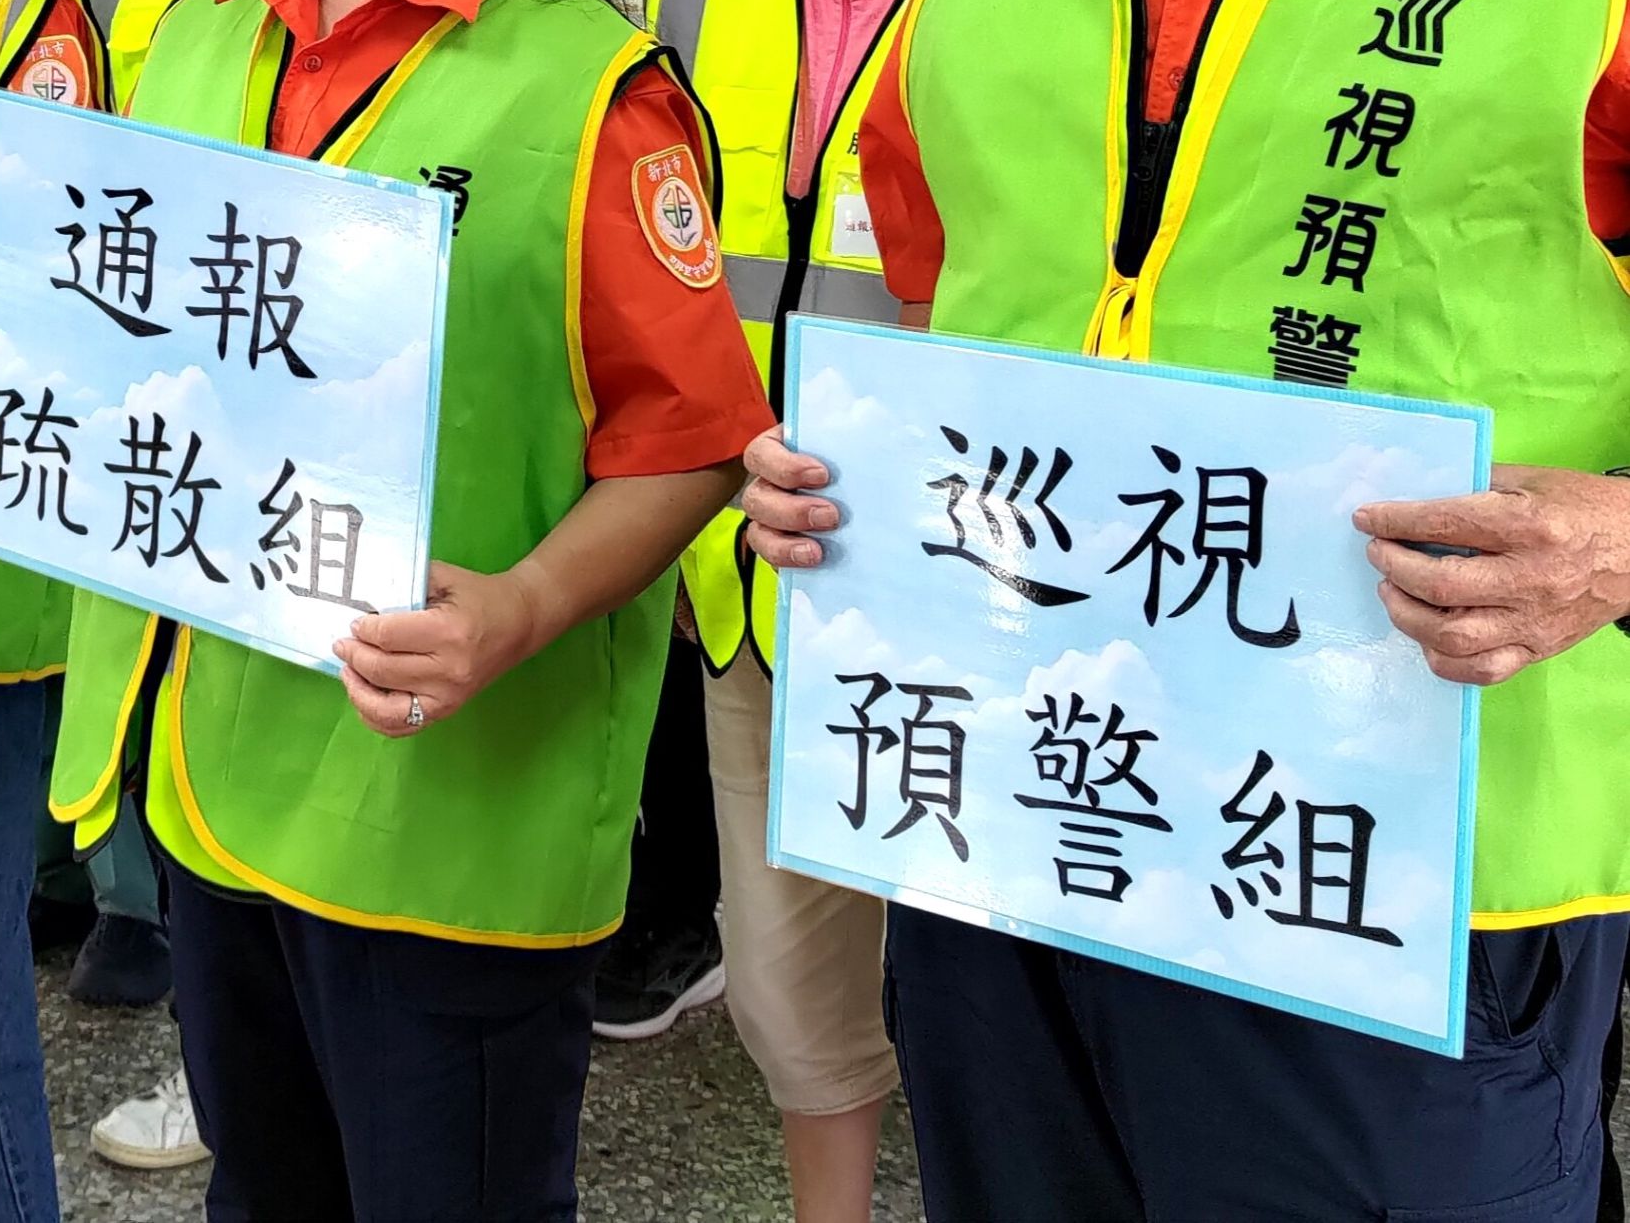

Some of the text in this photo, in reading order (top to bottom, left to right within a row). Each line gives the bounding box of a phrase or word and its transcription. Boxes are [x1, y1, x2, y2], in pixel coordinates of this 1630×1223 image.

[648, 155, 682, 182] 新北市
[50, 183, 318, 379] 通報
[920, 424, 1302, 650] 巡視
[826, 671, 1405, 948] 預警組
